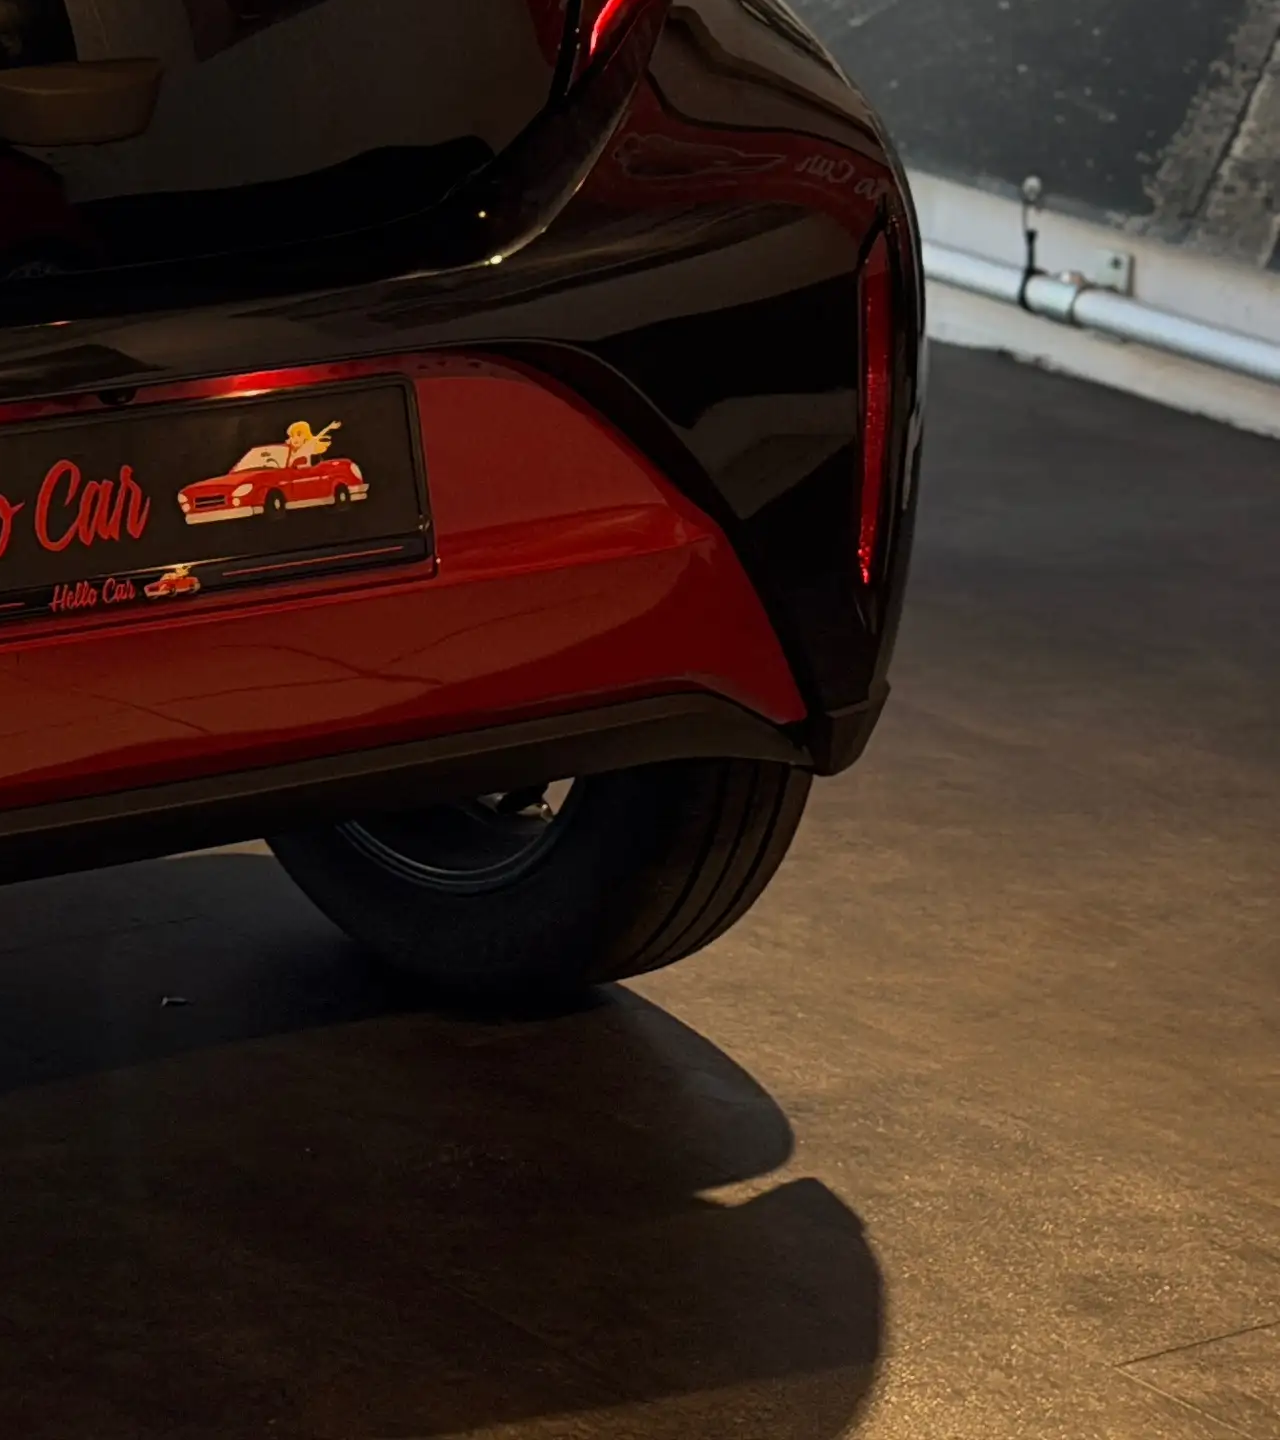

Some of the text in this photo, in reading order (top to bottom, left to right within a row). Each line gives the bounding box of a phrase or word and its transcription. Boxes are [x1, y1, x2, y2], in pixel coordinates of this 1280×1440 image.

[33, 458, 151, 553] Car
[48, 576, 137, 614] Hello Car
